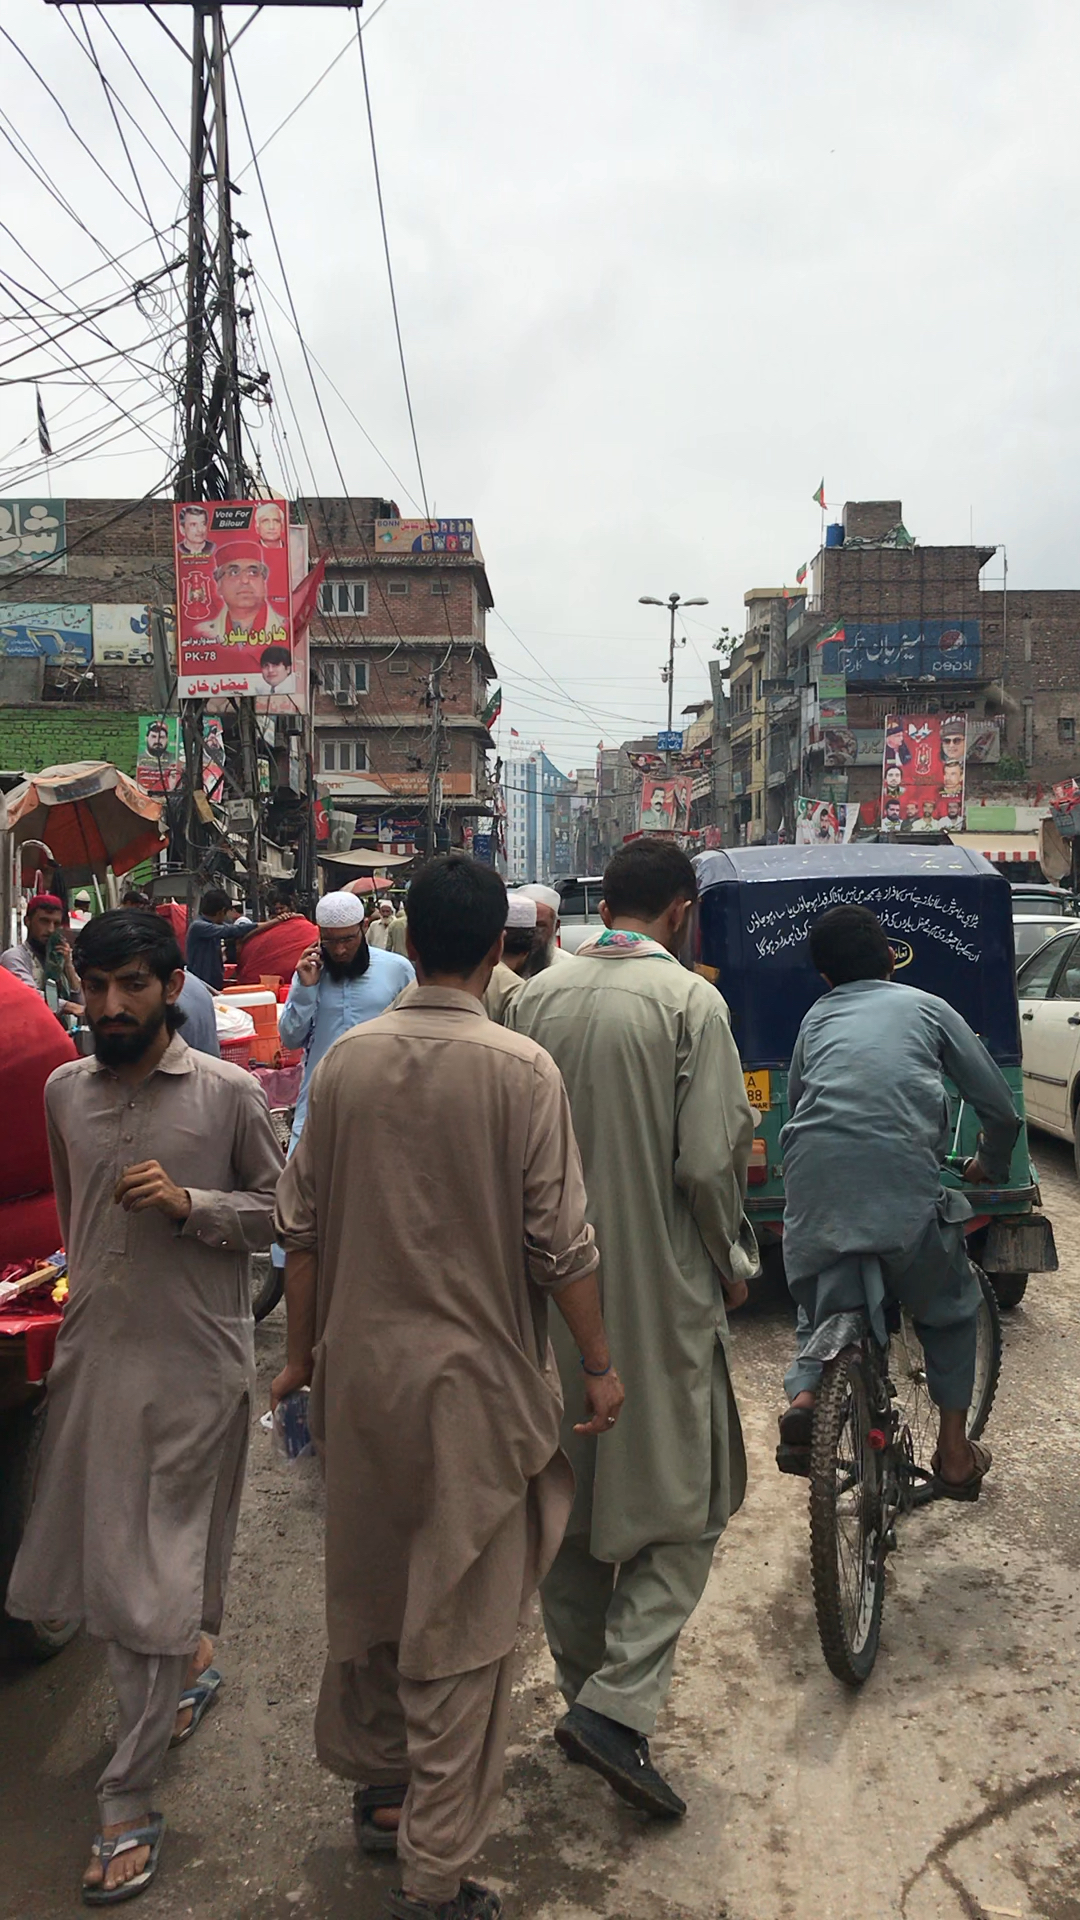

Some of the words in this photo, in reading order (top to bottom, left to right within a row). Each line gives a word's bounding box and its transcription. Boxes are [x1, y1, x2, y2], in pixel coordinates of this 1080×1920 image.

[234, 510, 250, 518] For
[219, 520, 244, 528] Bilour
[221, 626, 248, 647] بلور
[184, 651, 217, 661] PK-78
[187, 680, 210, 696] خان
[211, 678, 249, 695] فیضان
[840, 886, 856, 904] نہیں
